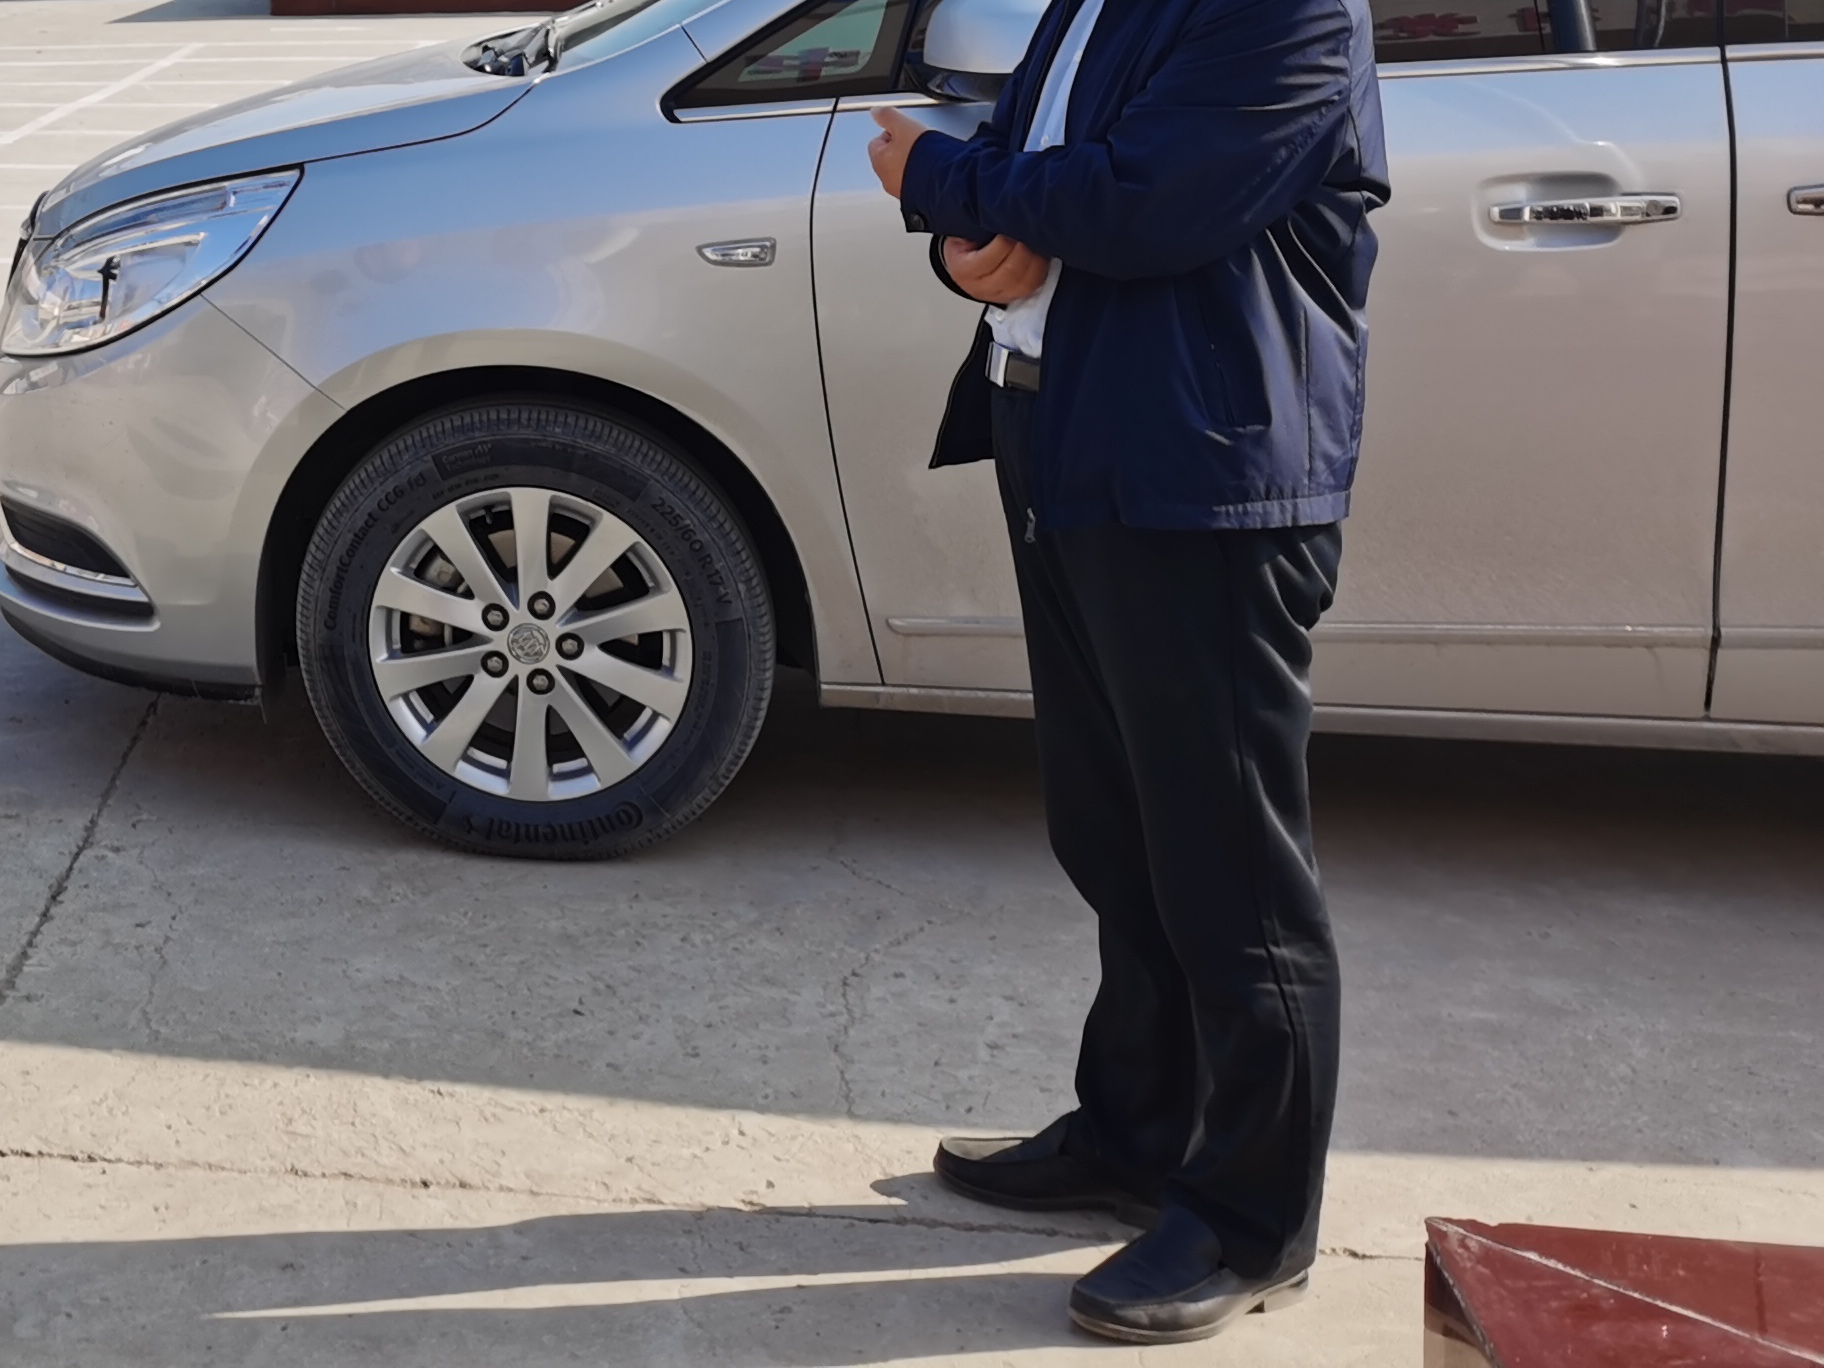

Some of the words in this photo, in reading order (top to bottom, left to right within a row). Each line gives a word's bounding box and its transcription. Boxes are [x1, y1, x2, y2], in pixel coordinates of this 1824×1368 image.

[651, 496, 704, 552] 225/60
[324, 511, 379, 630] ComfortContact
[484, 801, 644, 845] Continental
